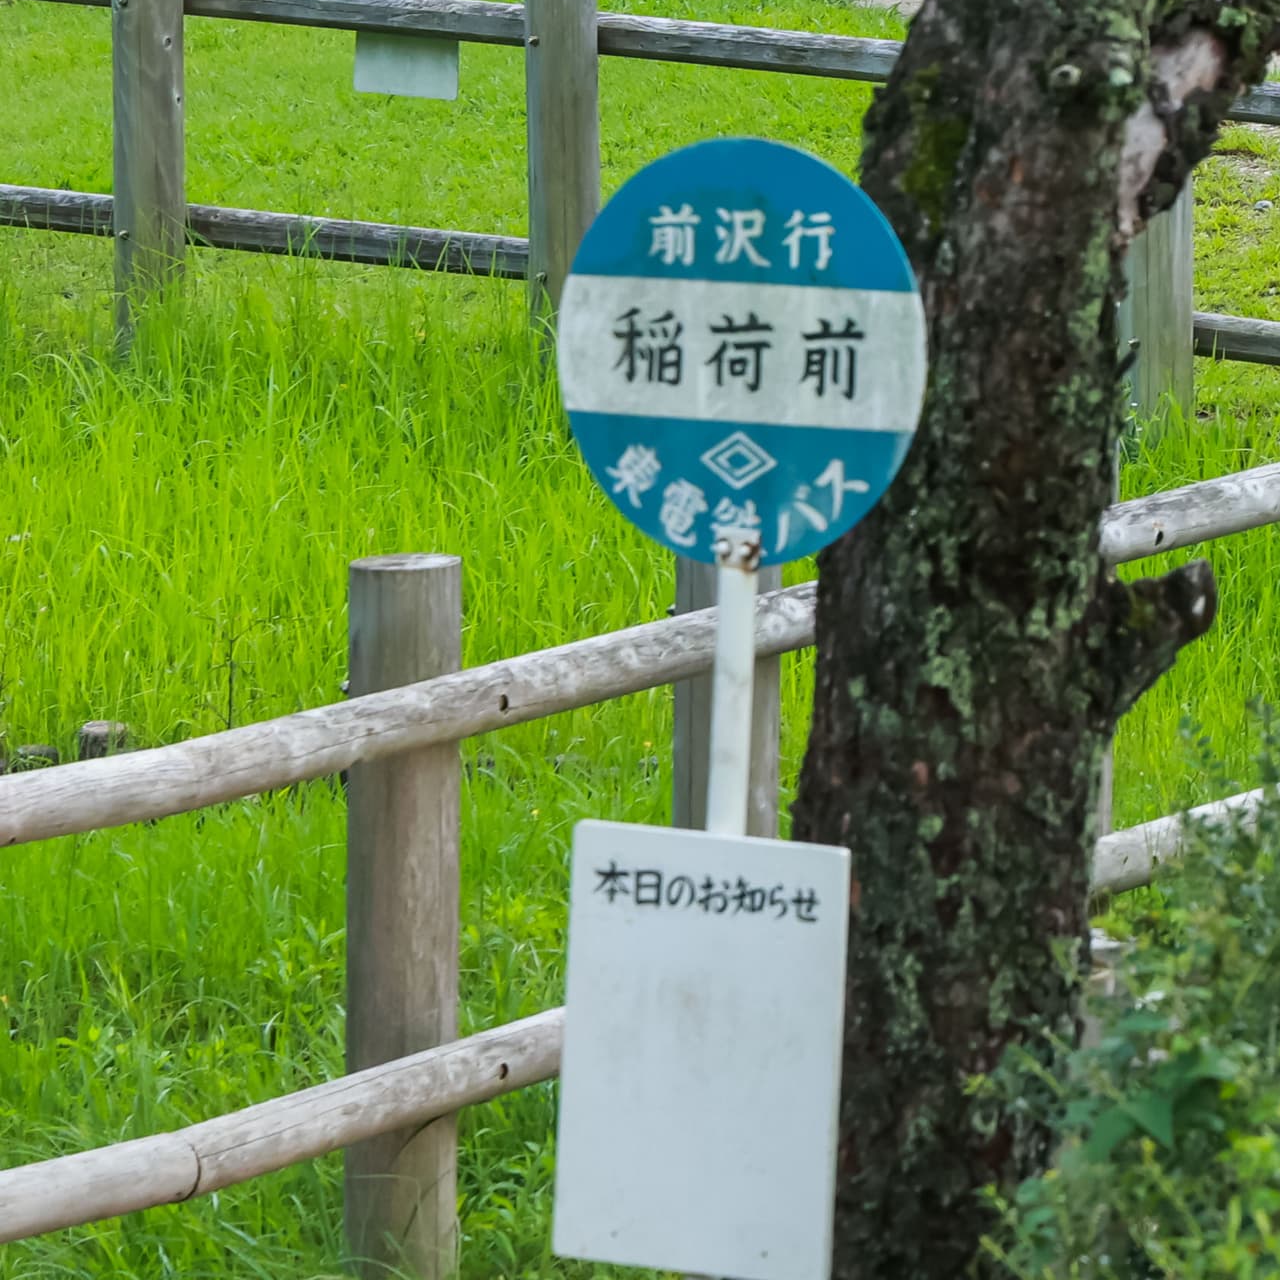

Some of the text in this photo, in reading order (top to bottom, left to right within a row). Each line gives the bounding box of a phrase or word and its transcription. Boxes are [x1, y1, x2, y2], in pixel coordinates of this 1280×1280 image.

[648, 203, 835, 270] 前沢行
[612, 306, 866, 400] 稲荷前
[593, 860, 822, 923] 本日のお知らせ
